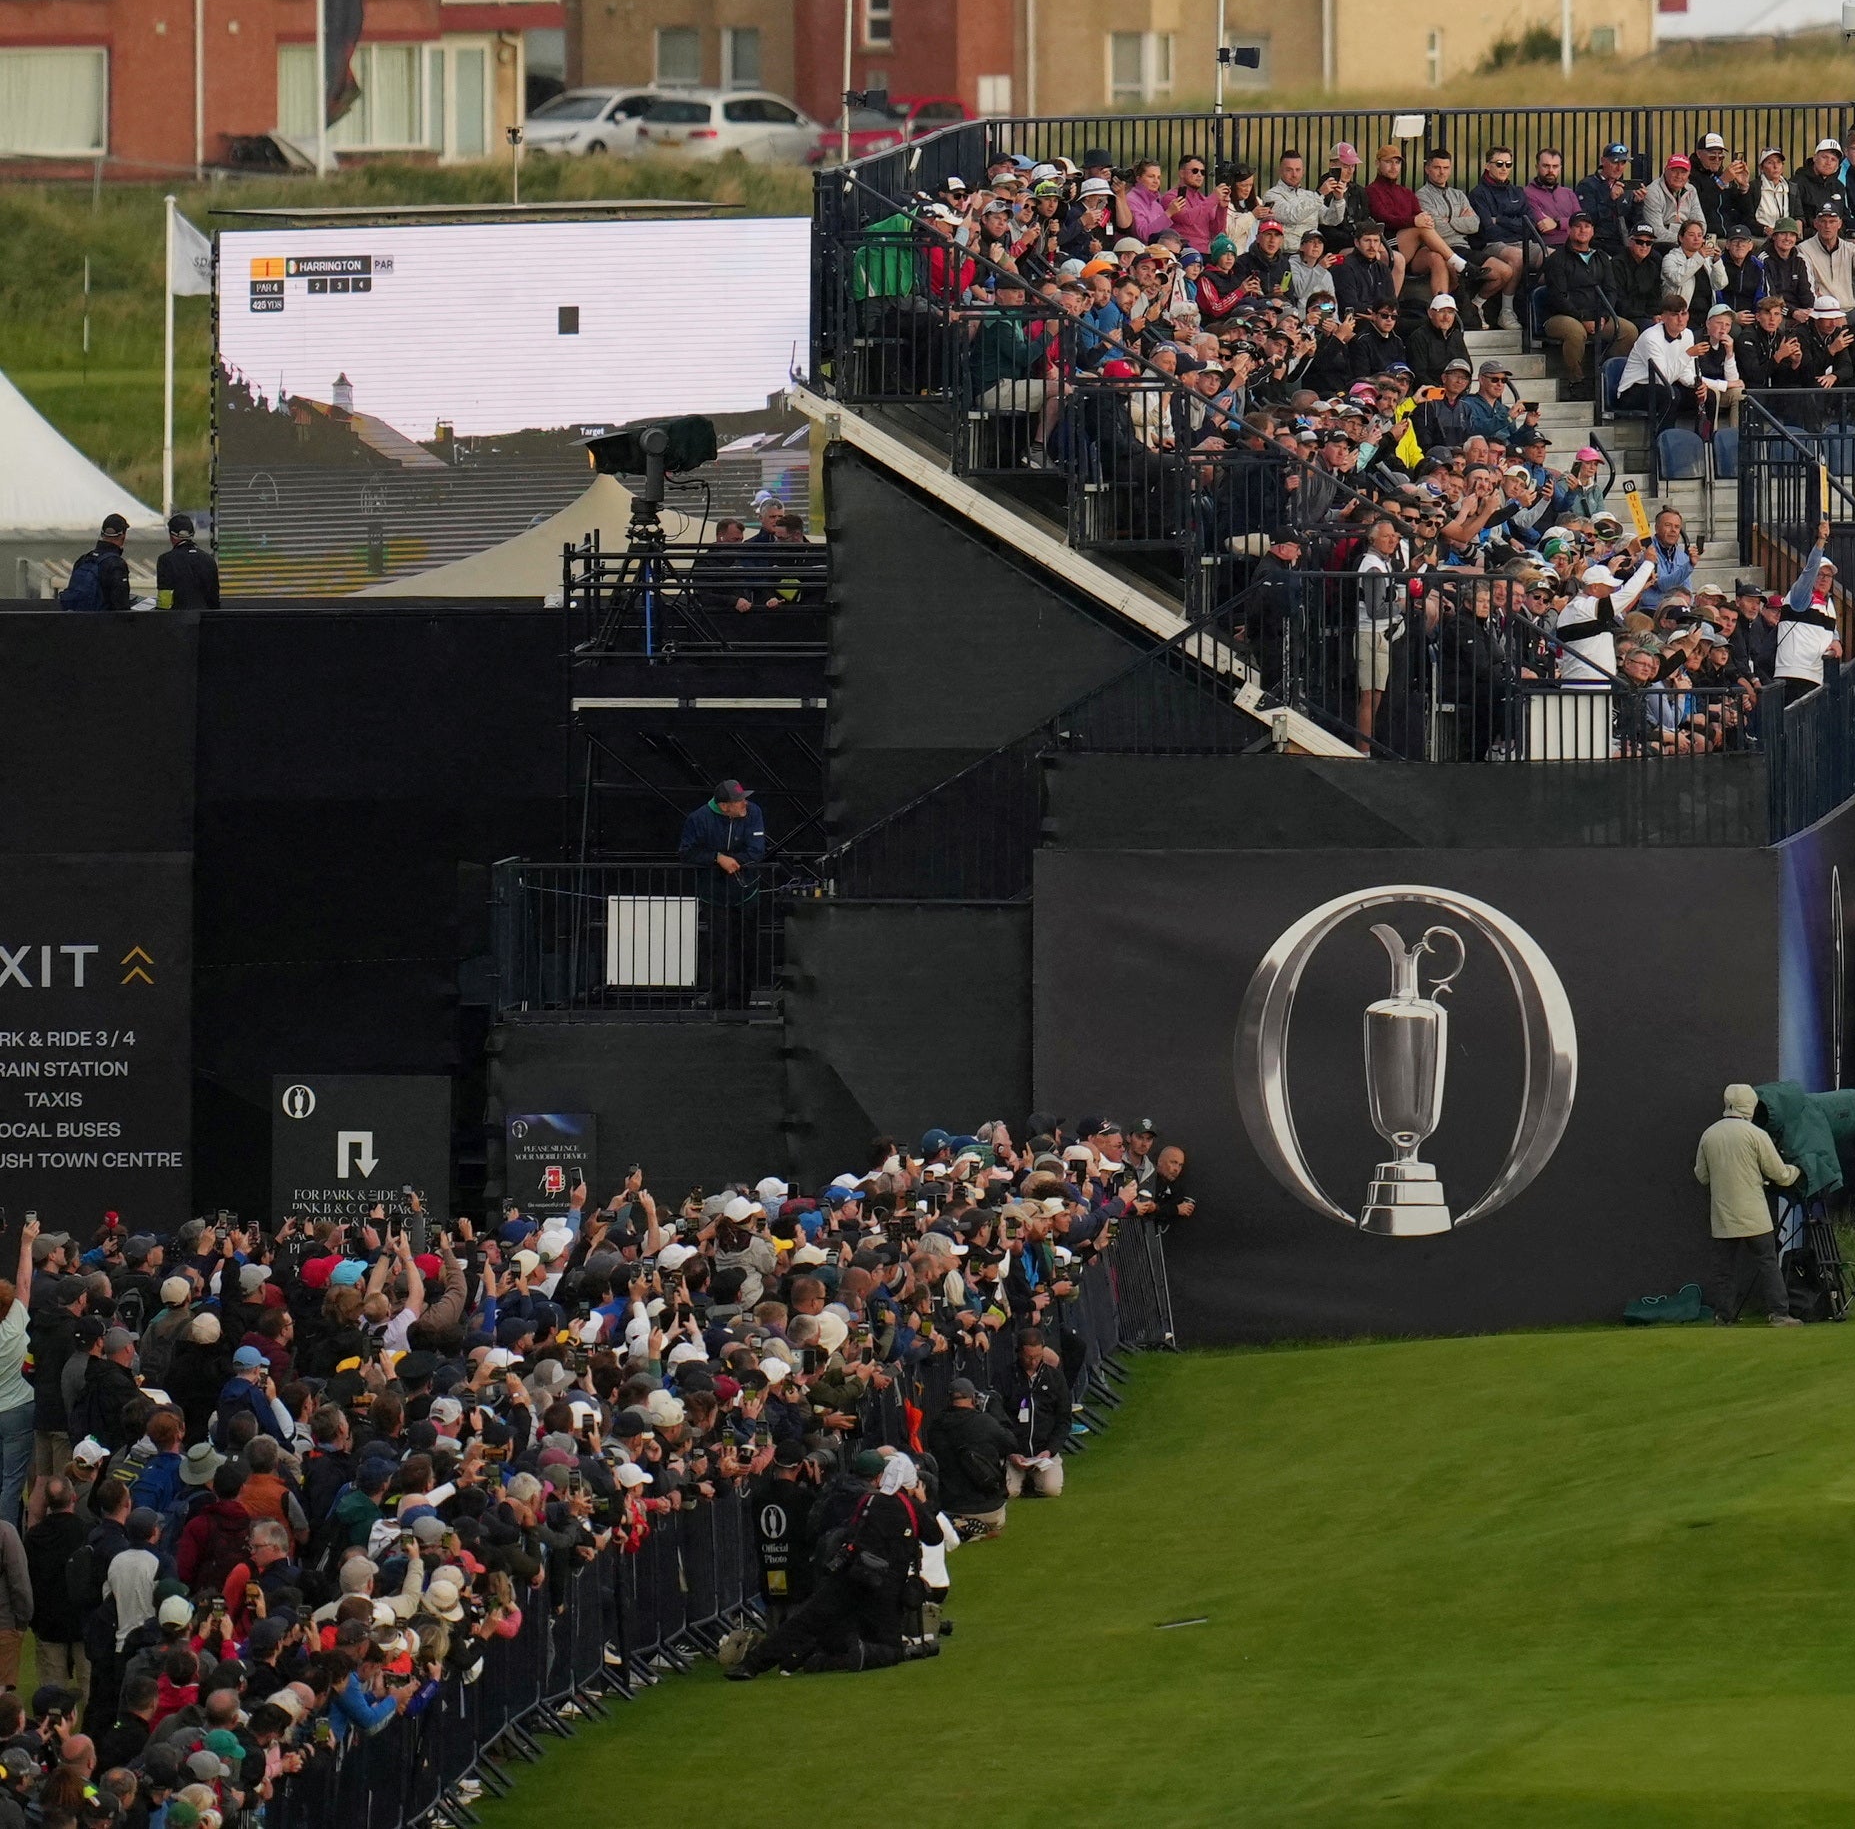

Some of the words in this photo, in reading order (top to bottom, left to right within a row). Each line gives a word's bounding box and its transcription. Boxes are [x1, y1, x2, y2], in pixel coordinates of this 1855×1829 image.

[299, 260, 361, 272] HARRINGTON
[374, 260, 393, 270] PAR
[256, 283, 271, 292] PAR
[272, 282, 279, 292] 4
[315, 282, 320, 290] 2
[358, 281, 364, 289] 4
[580, 427, 604, 437] Target
[0, 945, 99, 988] XIT
[0, 1031, 25, 1047] RK
[28, 1031, 43, 1047] &
[47, 1031, 92, 1047] RIDE
[96, 1031, 107, 1047] 3
[122, 1031, 136, 1046] 4
[44, 1061, 129, 1077] STATION
[25, 1092, 83, 1108] TAXIS
[0, 1122, 52, 1138] OCAL
[57, 1122, 121, 1138] BUSES
[38, 1153, 98, 1168] TOWN
[102, 1152, 182, 1168] CENTRE
[294, 1189, 320, 1201] FOR
[323, 1189, 352, 1201] PARK
[357, 1189, 367, 1201] &
[323, 1203, 332, 1214] B
[334, 1203, 344, 1214] &
[346, 1203, 356, 1214] C
[761, 1543, 789, 1553] Official
[764, 1554, 787, 1564] Photo
